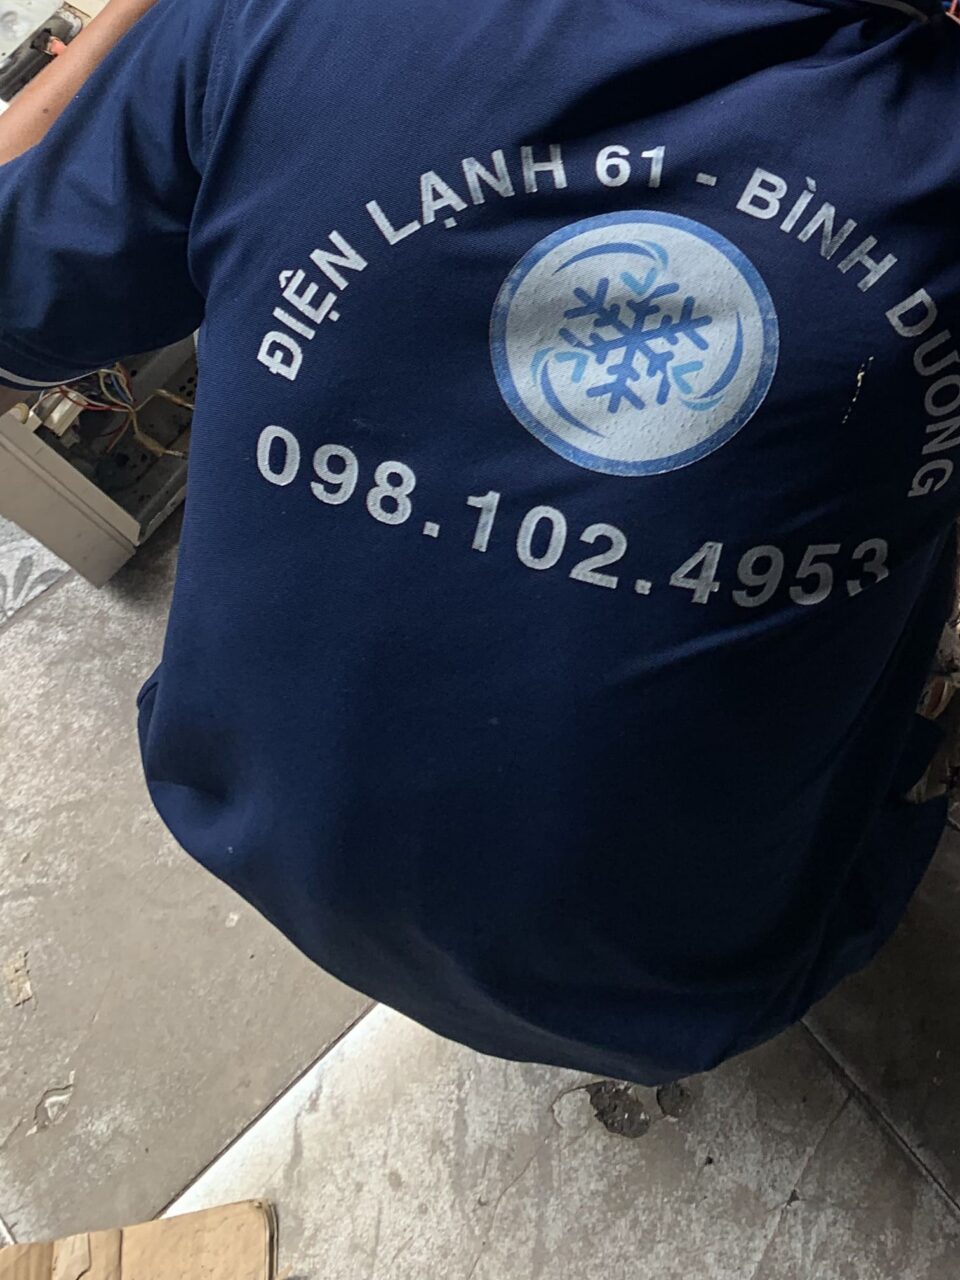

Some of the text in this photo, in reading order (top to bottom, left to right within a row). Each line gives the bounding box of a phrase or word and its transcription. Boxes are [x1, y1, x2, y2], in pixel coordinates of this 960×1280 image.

[256, 229, 368, 382] ĐIỆN
[364, 144, 569, 246] LẠNH
[589, 144, 667, 188] 61
[735, 166, 899, 293] BÌNH
[255, 424, 890, 608] 098.102.4953
